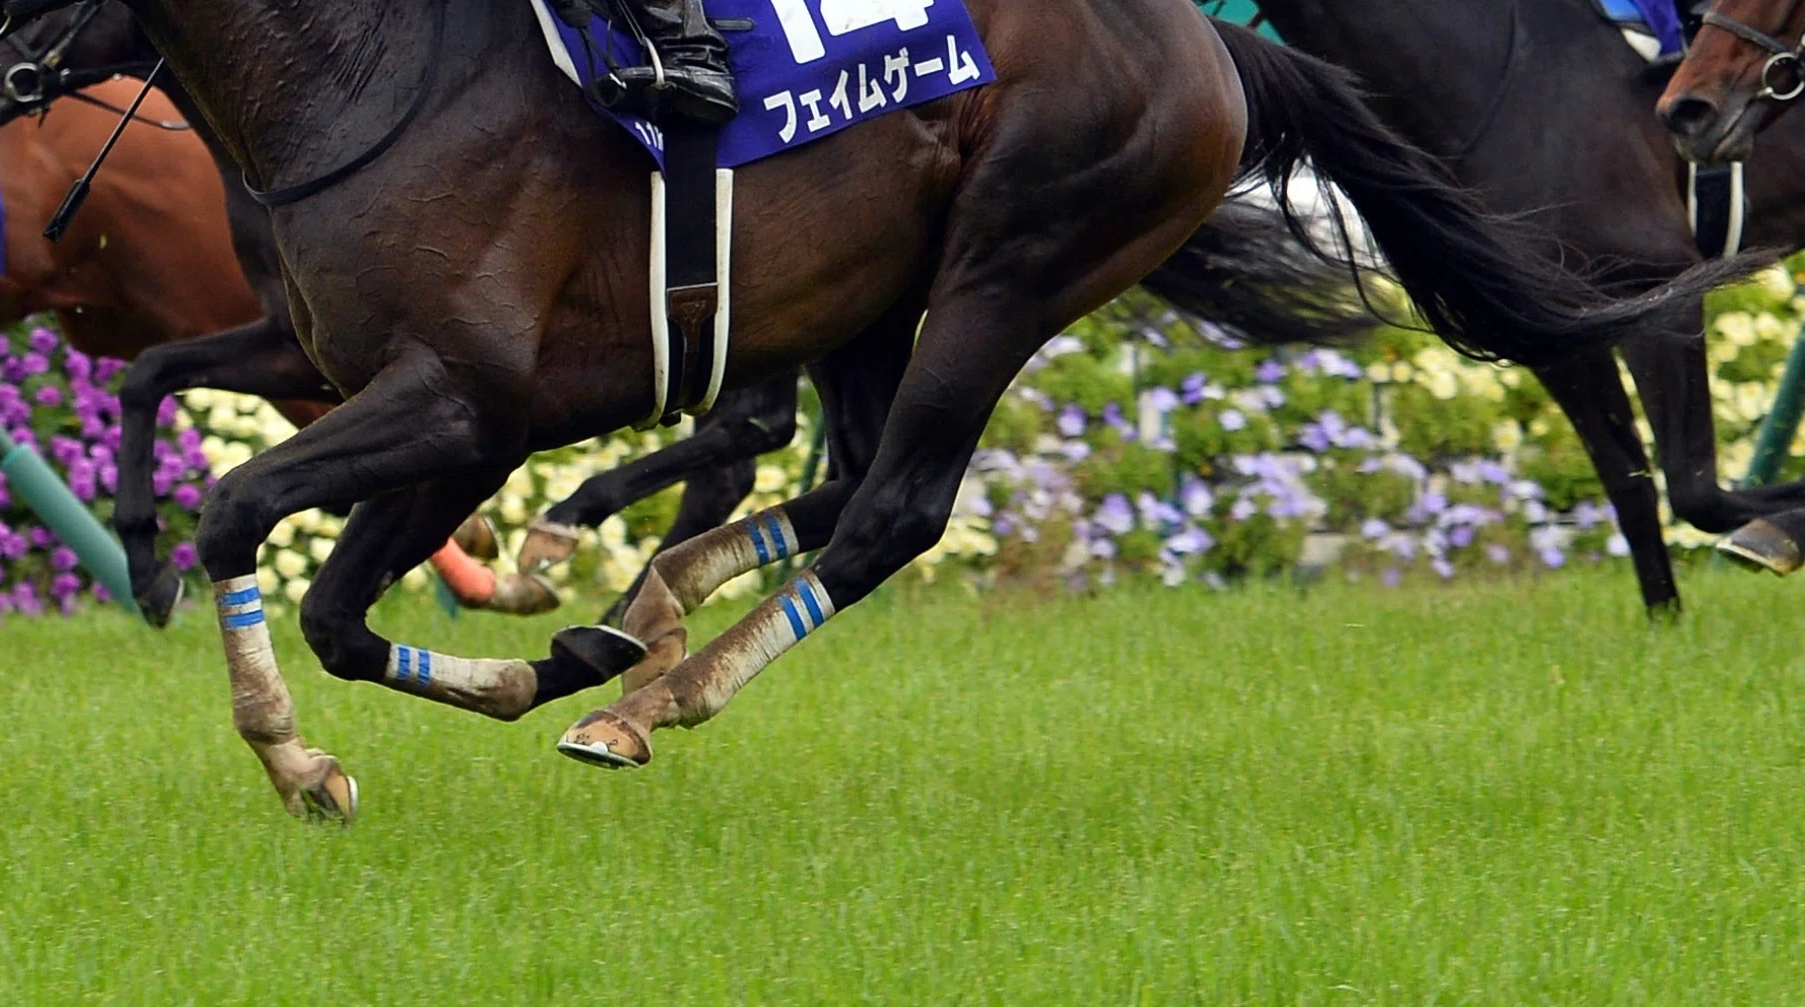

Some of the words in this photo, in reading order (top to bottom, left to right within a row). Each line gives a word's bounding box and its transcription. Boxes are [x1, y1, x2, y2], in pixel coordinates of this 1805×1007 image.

[763, 34, 981, 143] フェイムゲーム
